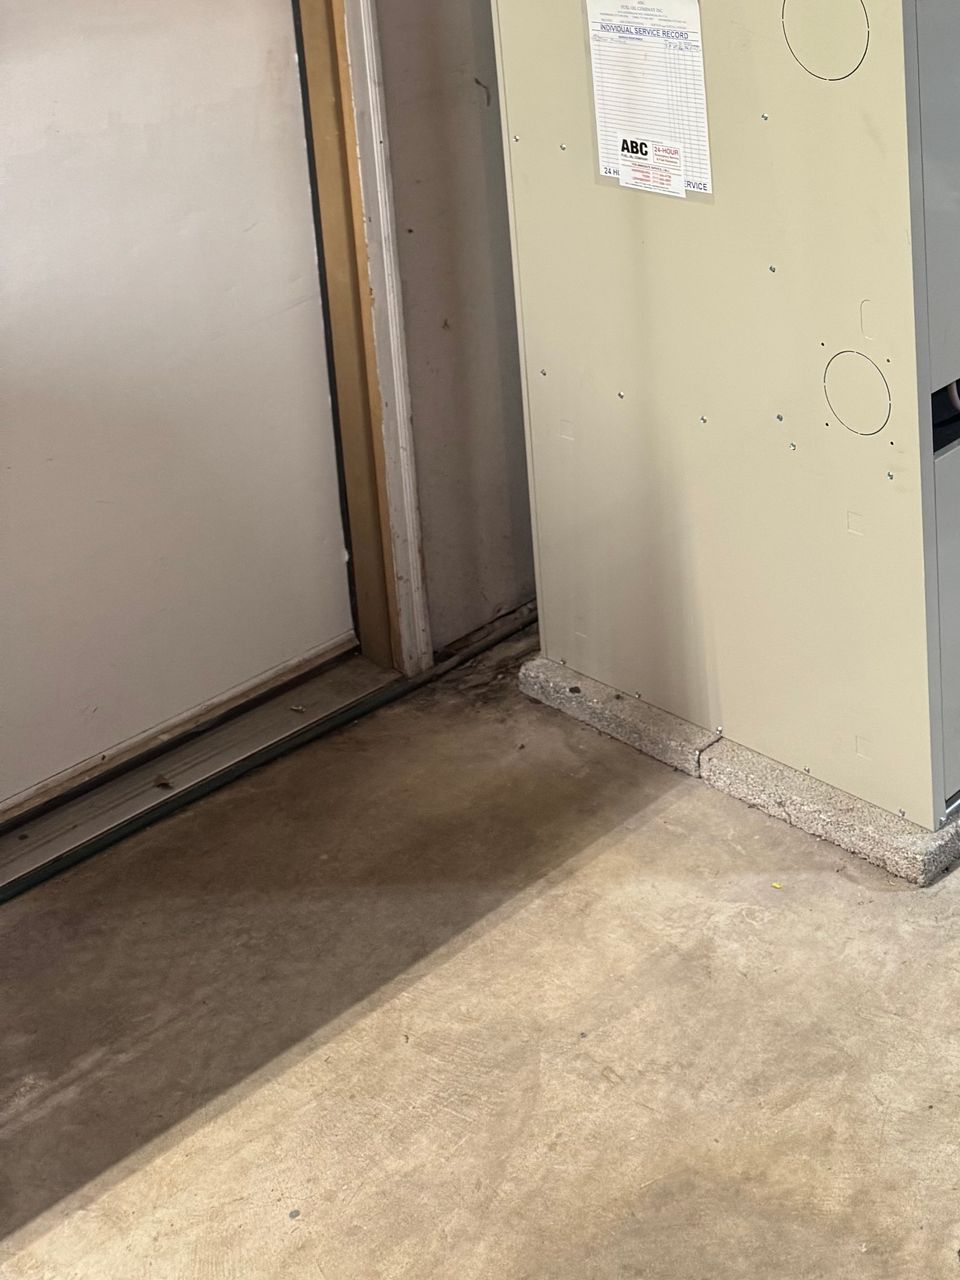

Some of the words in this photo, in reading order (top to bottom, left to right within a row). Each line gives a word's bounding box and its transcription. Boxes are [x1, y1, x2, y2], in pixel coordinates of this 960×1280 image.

[634, 27, 661, 37] SERVICE
[661, 30, 689, 40] RECORD
[621, 138, 649, 156] ABC
[654, 146, 679, 156] 24-HOUR
[603, 166, 612, 175] 24
